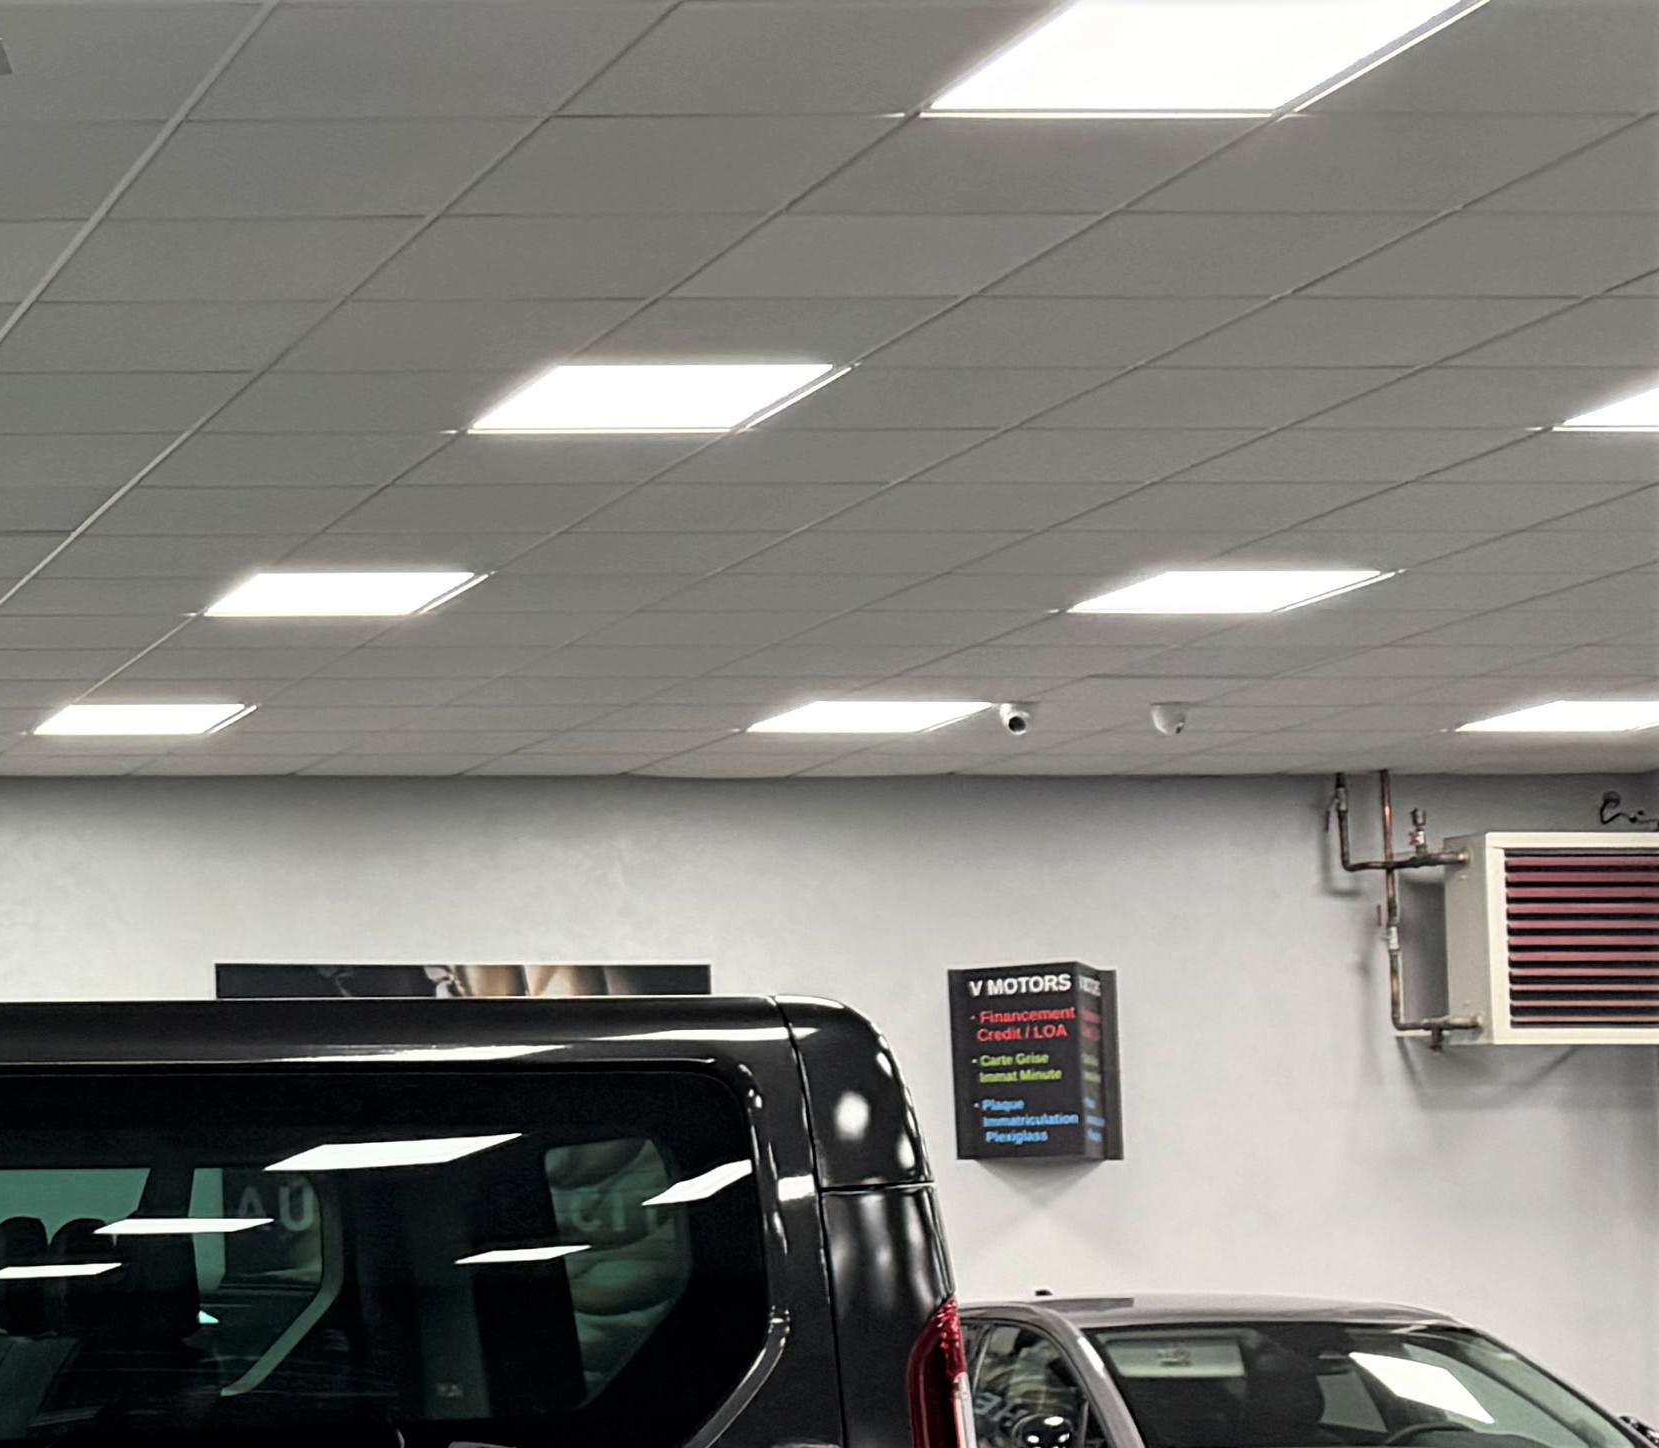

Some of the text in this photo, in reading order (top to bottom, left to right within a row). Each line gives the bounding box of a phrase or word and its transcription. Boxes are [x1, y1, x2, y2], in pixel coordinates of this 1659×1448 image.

[969, 980, 983, 997] V
[987, 974, 1071, 995] MOTORS
[980, 1007, 1075, 1023] Financement
[1033, 1024, 1067, 1038] LOA
[980, 1052, 1050, 1067] Carte Grise
[982, 1099, 1025, 1112] Plaque
[982, 1113, 1079, 1128] Immatriculation
[986, 1131, 1048, 1144] Plexiglass
